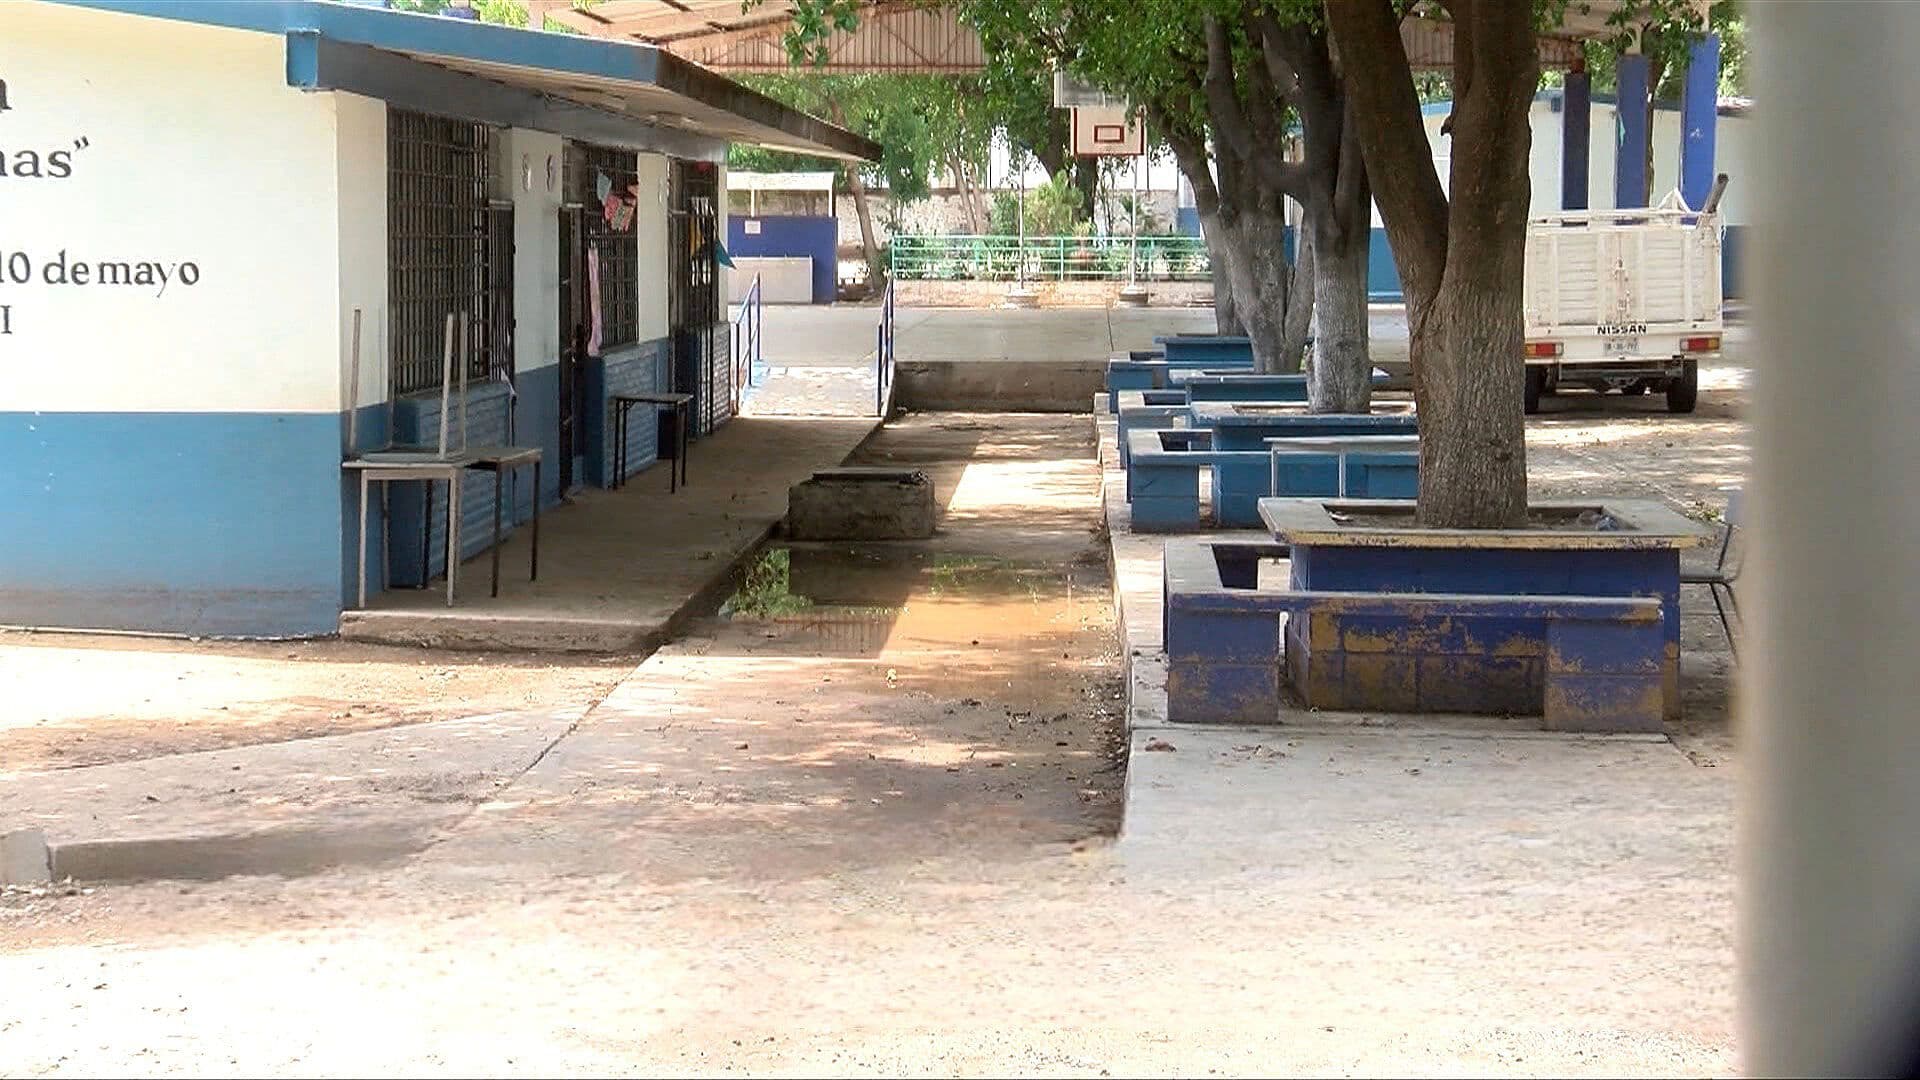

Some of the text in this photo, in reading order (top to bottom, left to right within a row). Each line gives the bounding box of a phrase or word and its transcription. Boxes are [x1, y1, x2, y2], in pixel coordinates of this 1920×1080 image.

[43, 248, 89, 285] de
[97, 261, 200, 299] mayo
[1597, 324, 1647, 335] NISSAN
